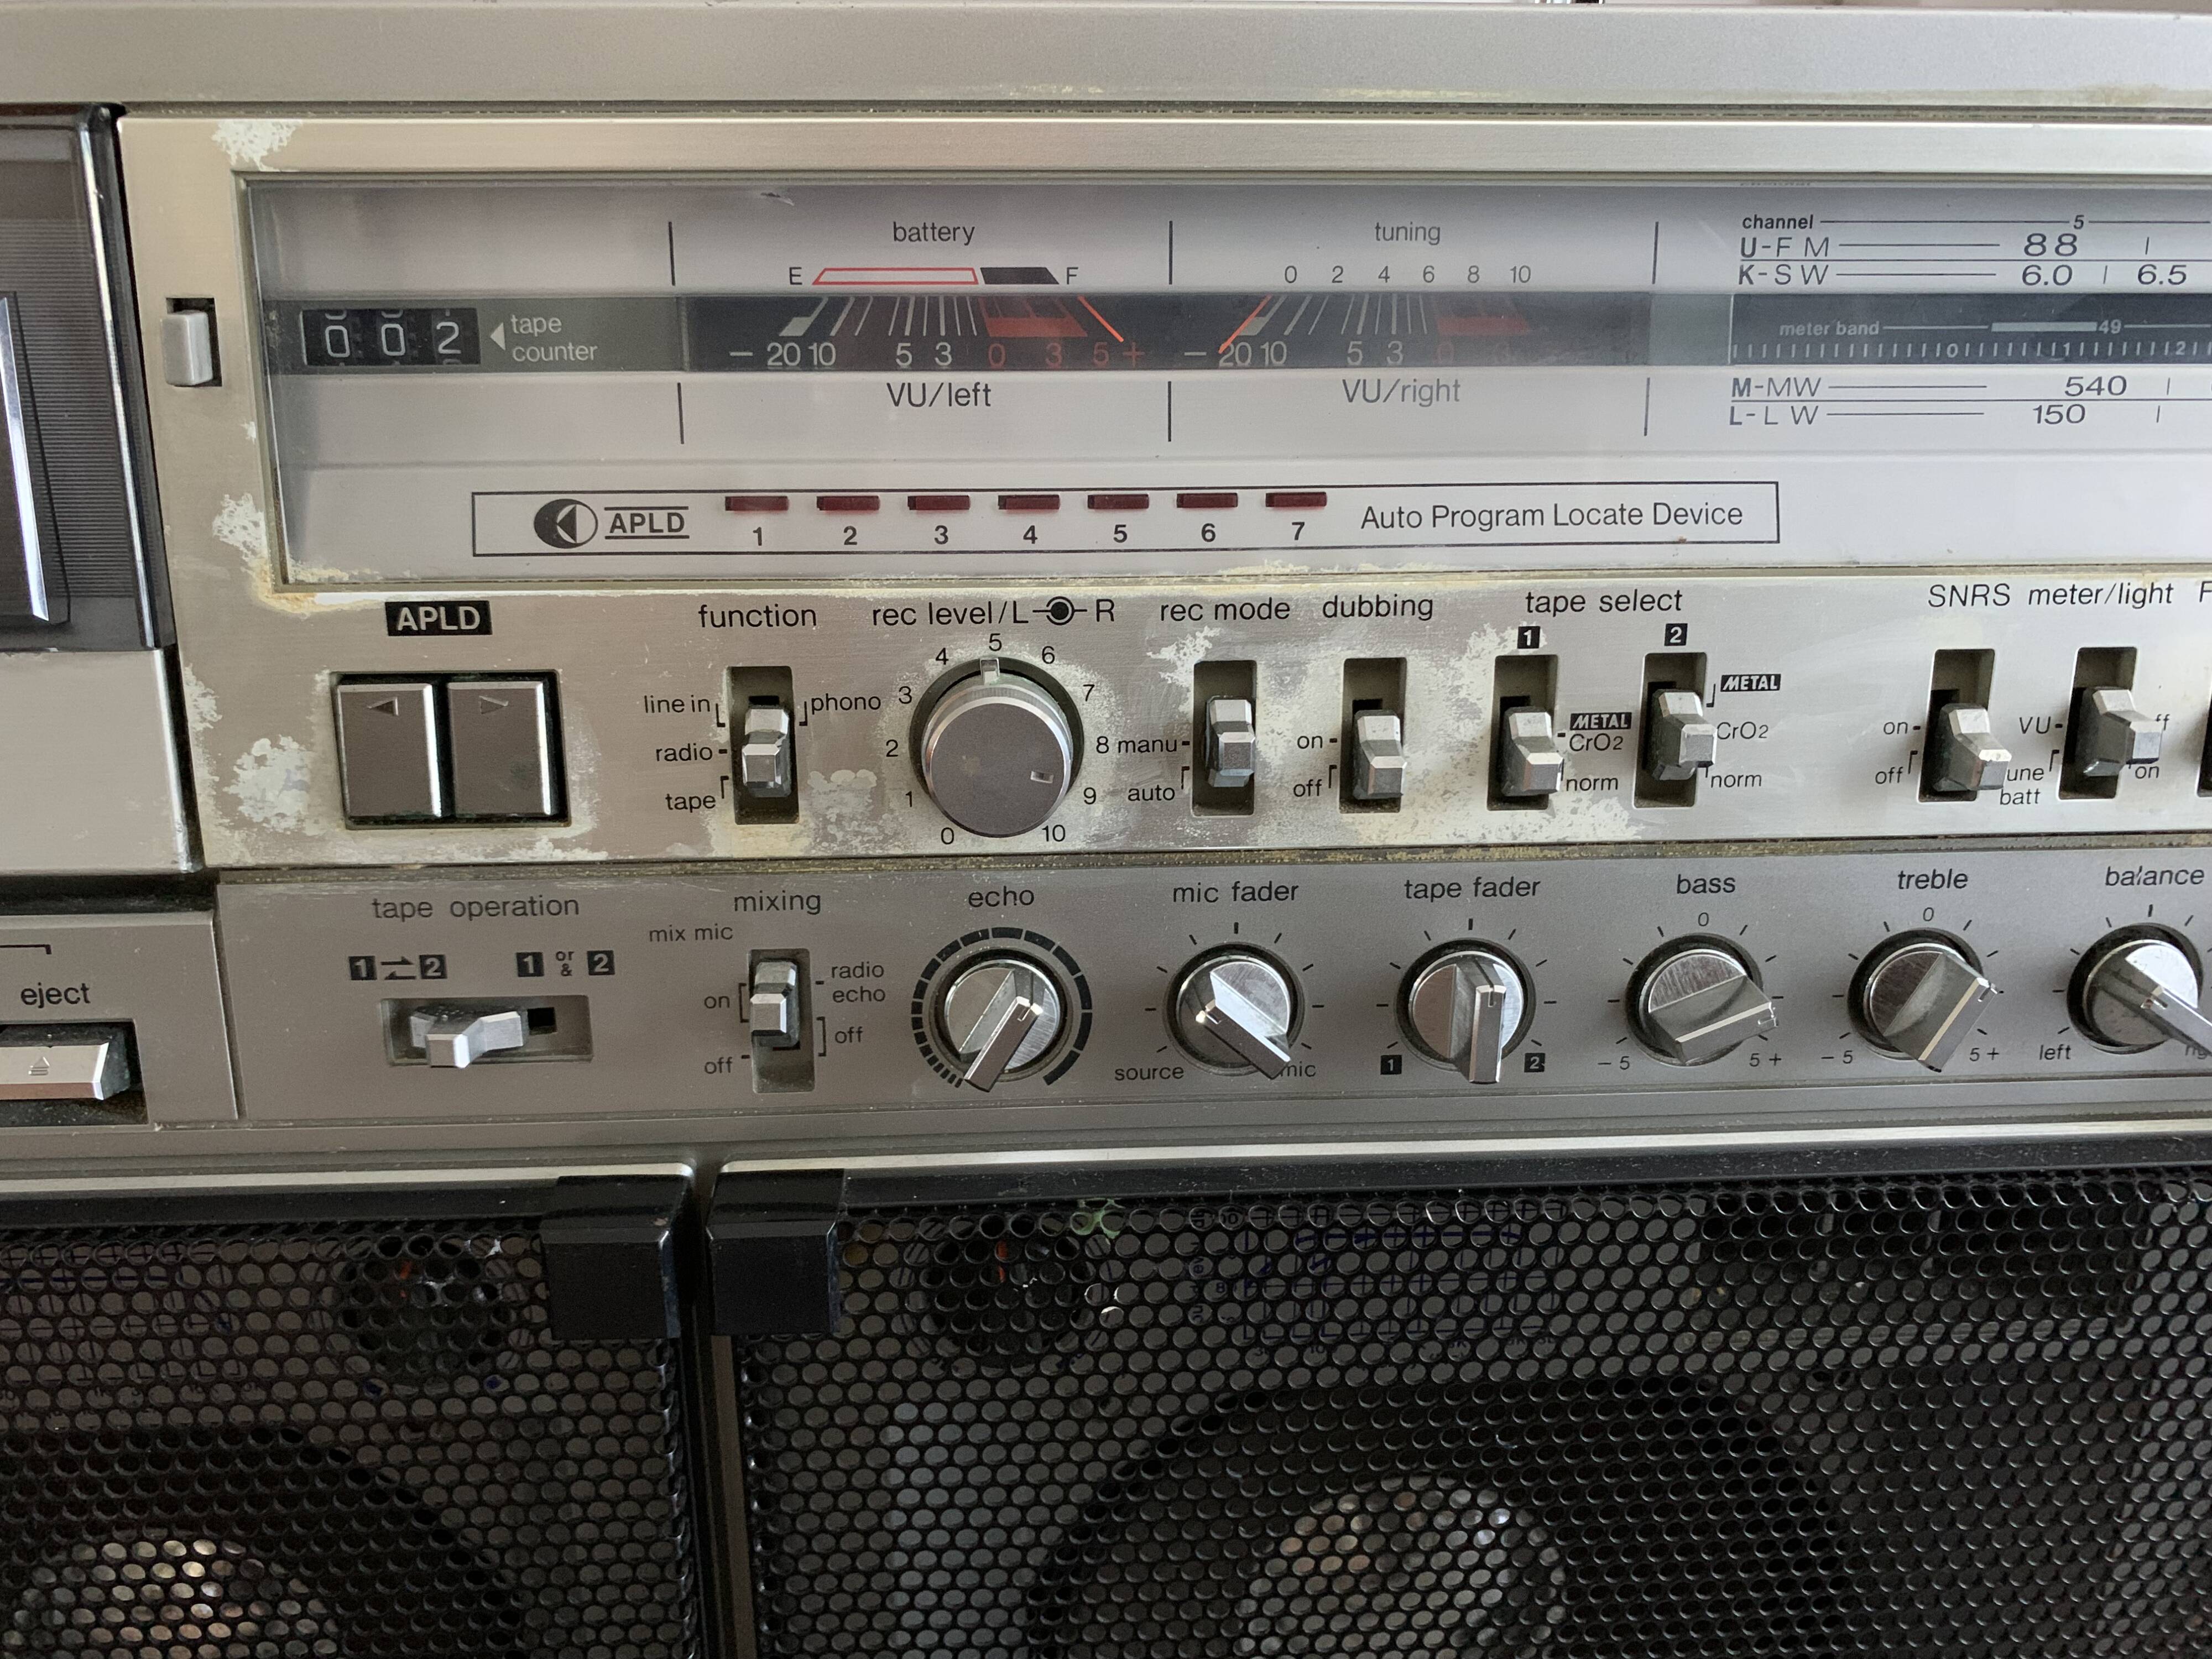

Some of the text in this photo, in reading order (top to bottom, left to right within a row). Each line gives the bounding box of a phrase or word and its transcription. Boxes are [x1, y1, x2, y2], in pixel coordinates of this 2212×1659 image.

[1742, 214, 1813, 229] channel
[2074, 215, 2084, 229] 5
[893, 222, 975, 245] battery
[1375, 222, 1441, 245] tuning
[2024, 233, 2077, 256] 88
[789, 268, 802, 285] E
[1067, 268, 1078, 284] F
[1285, 266, 1531, 284] 0 2 4 6 8 10
[2022, 264, 2187, 286] 6.0 6.5
[512, 314, 562, 337] tape
[1780, 319, 2122, 336] meter band 49
[513, 343, 598, 361] counter
[767, 343, 801, 367] 20
[810, 343, 836, 367] 10
[896, 343, 912, 367] 5
[935, 343, 952, 367] 3
[989, 343, 1005, 367] 0
[1046, 343, 1061, 367] 3
[1093, 343, 1109, 367] 5
[1219, 342, 1251, 367] 20
[1261, 342, 1286, 365] 10
[1348, 342, 1363, 365] 5
[1387, 342, 1403, 365] 3
[2176, 341, 2185, 355] 2
[1343, 379, 1460, 406] VU/right
[2065, 375, 2127, 397] 540
[886, 383, 992, 408] VU/left
[2033, 404, 2085, 425] 150
[609, 512, 686, 534] APLD
[1360, 502, 1743, 533] Auto Program Locate Device
[753, 521, 1306, 546] 1 2 3 4 5 6 7
[1526, 589, 1683, 617] tape select
[1928, 584, 2010, 608] SNRS
[2028, 582, 2173, 609] meter/light
[698, 604, 817, 628] function
[873, 607, 916, 626] rec
[1096, 599, 1115, 621] R
[1161, 597, 1291, 620] rec mode
[1323, 595, 1433, 620] dubbing
[396, 606, 481, 632] APLD
[989, 634, 1003, 651] 5
[935, 648, 949, 665] 4
[1042, 646, 1055, 663] 6
[1723, 675, 1778, 690] METAL
[899, 686, 912, 704] 3
[1083, 684, 1095, 701] 7
[644, 696, 711, 713] line in
[811, 693, 881, 715] phono
[1573, 713, 1629, 728] METAL
[1884, 722, 1908, 734] on
[2020, 717, 2051, 734] VU
[886, 740, 899, 757] 2
[1096, 737, 1109, 754] 8
[1117, 739, 1178, 754] manu
[1297, 735, 1323, 749] on
[656, 743, 713, 761] radio
[1711, 773, 1762, 788] norm
[1875, 767, 1903, 784] off
[2007, 769, 2044, 781] une
[2135, 766, 2159, 779] on
[1292, 780, 1323, 798] off
[1566, 776, 1619, 791] norm
[905, 792, 914, 807] 1
[1083, 788, 1097, 805] 9
[1128, 786, 1175, 801] auto
[2000, 789, 2041, 805] batt
[665, 792, 717, 813] tape
[941, 828, 954, 844] 0
[1043, 825, 1065, 841] 10
[1677, 874, 1735, 894] bass
[1898, 869, 1968, 889] treble
[2105, 865, 2204, 886] balance
[969, 886, 1035, 907] echo
[1173, 880, 1300, 903] mic fader
[1404, 877, 1541, 901] tape fader
[373, 895, 580, 921] tape operation
[734, 891, 821, 914] mixing
[1698, 912, 1709, 926] 0
[1923, 907, 1934, 921] 0
[649, 924, 734, 942] mix mic
[556, 950, 574, 961] or
[561, 964, 572, 977] &
[832, 962, 884, 979] radio
[20, 982, 91, 1008] eject
[705, 995, 730, 1009] on
[833, 987, 885, 1003] echo
[835, 1027, 863, 1044] off
[2039, 1044, 2071, 1060] left
[705, 1057, 732, 1074] off
[1114, 1065, 1184, 1081] source
